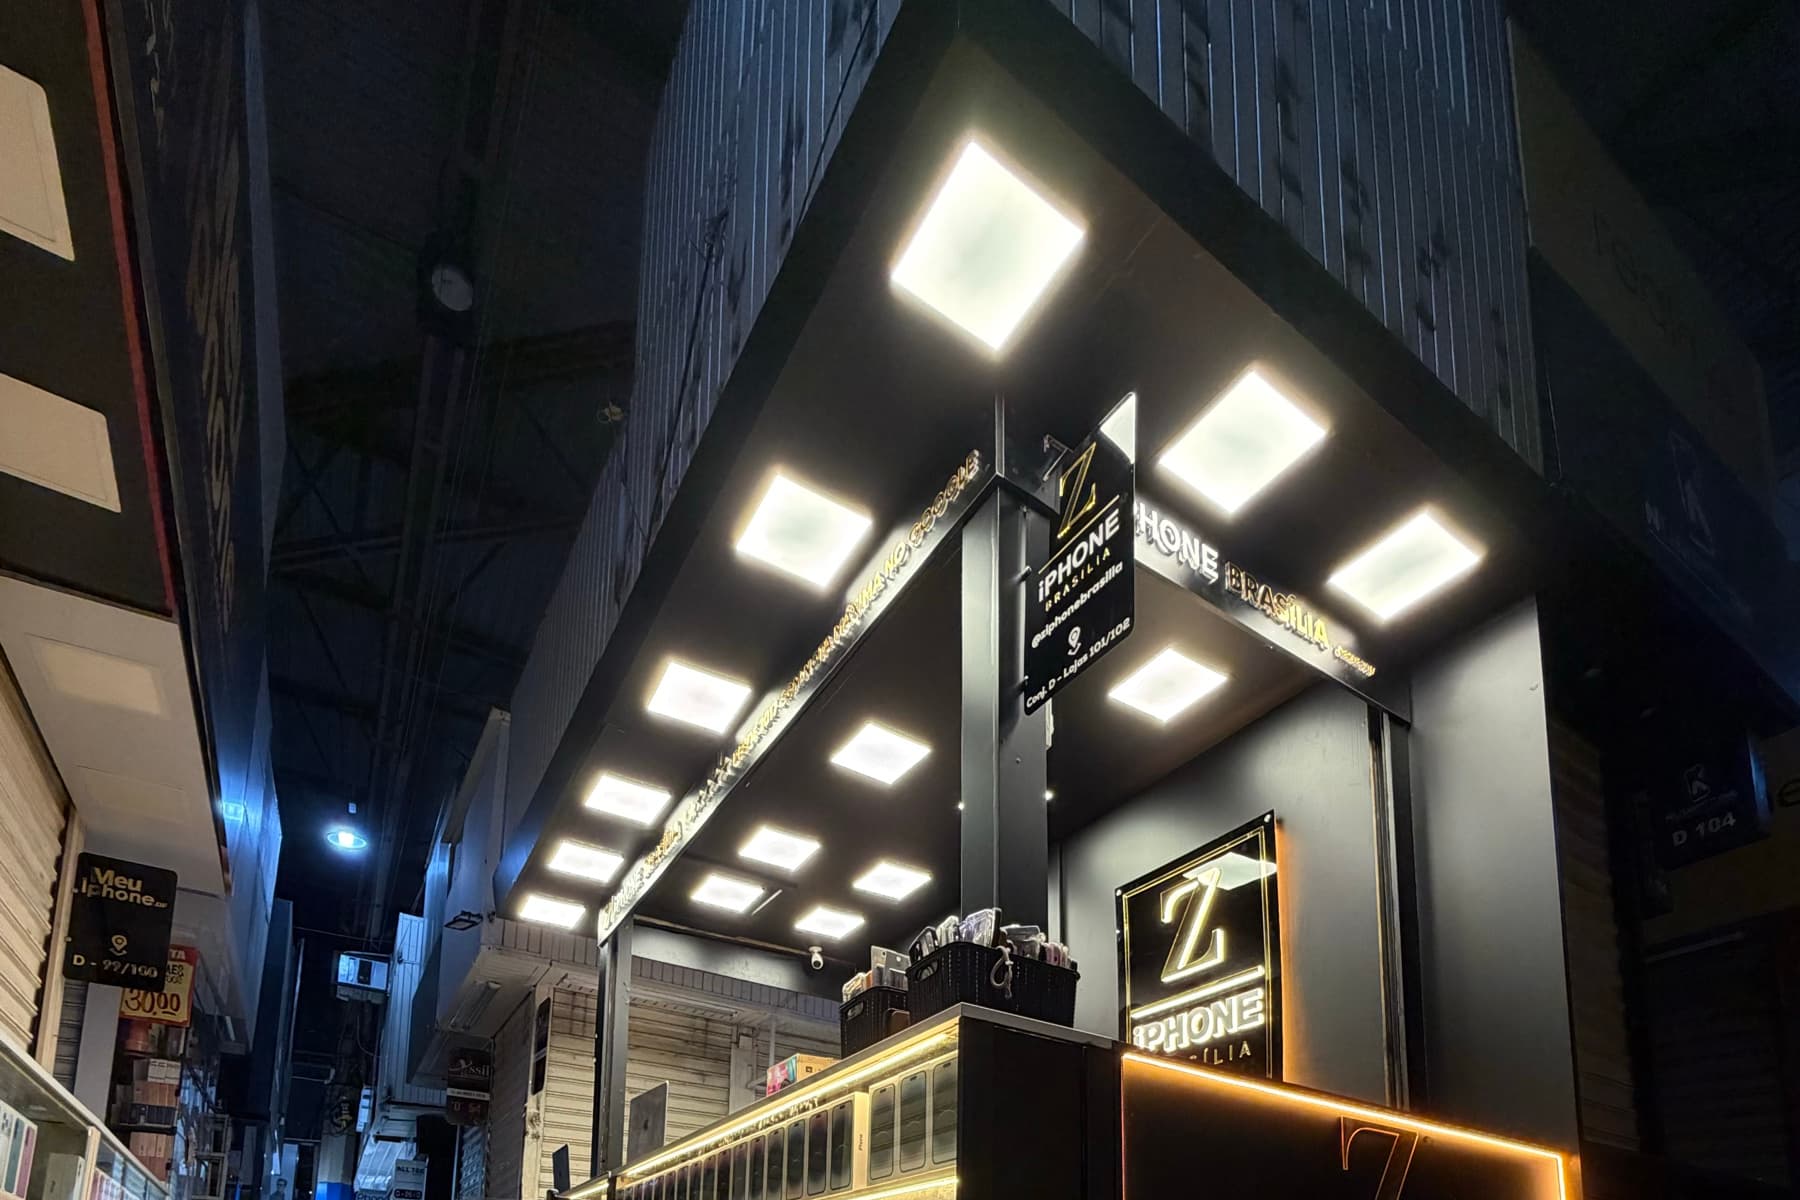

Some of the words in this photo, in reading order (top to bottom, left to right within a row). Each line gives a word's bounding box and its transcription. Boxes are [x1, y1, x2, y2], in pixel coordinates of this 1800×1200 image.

[1057, 442, 1096, 538] Z
[1038, 509, 1119, 602] iPHONE
[1063, 653, 1088, 678] Lojas
[1089, 617, 1130, 657] 101/102
[91, 866, 142, 891] Meu
[1160, 867, 1224, 982] Z
[73, 954, 85, 966] D
[1133, 988, 1264, 1053] iPHONE
